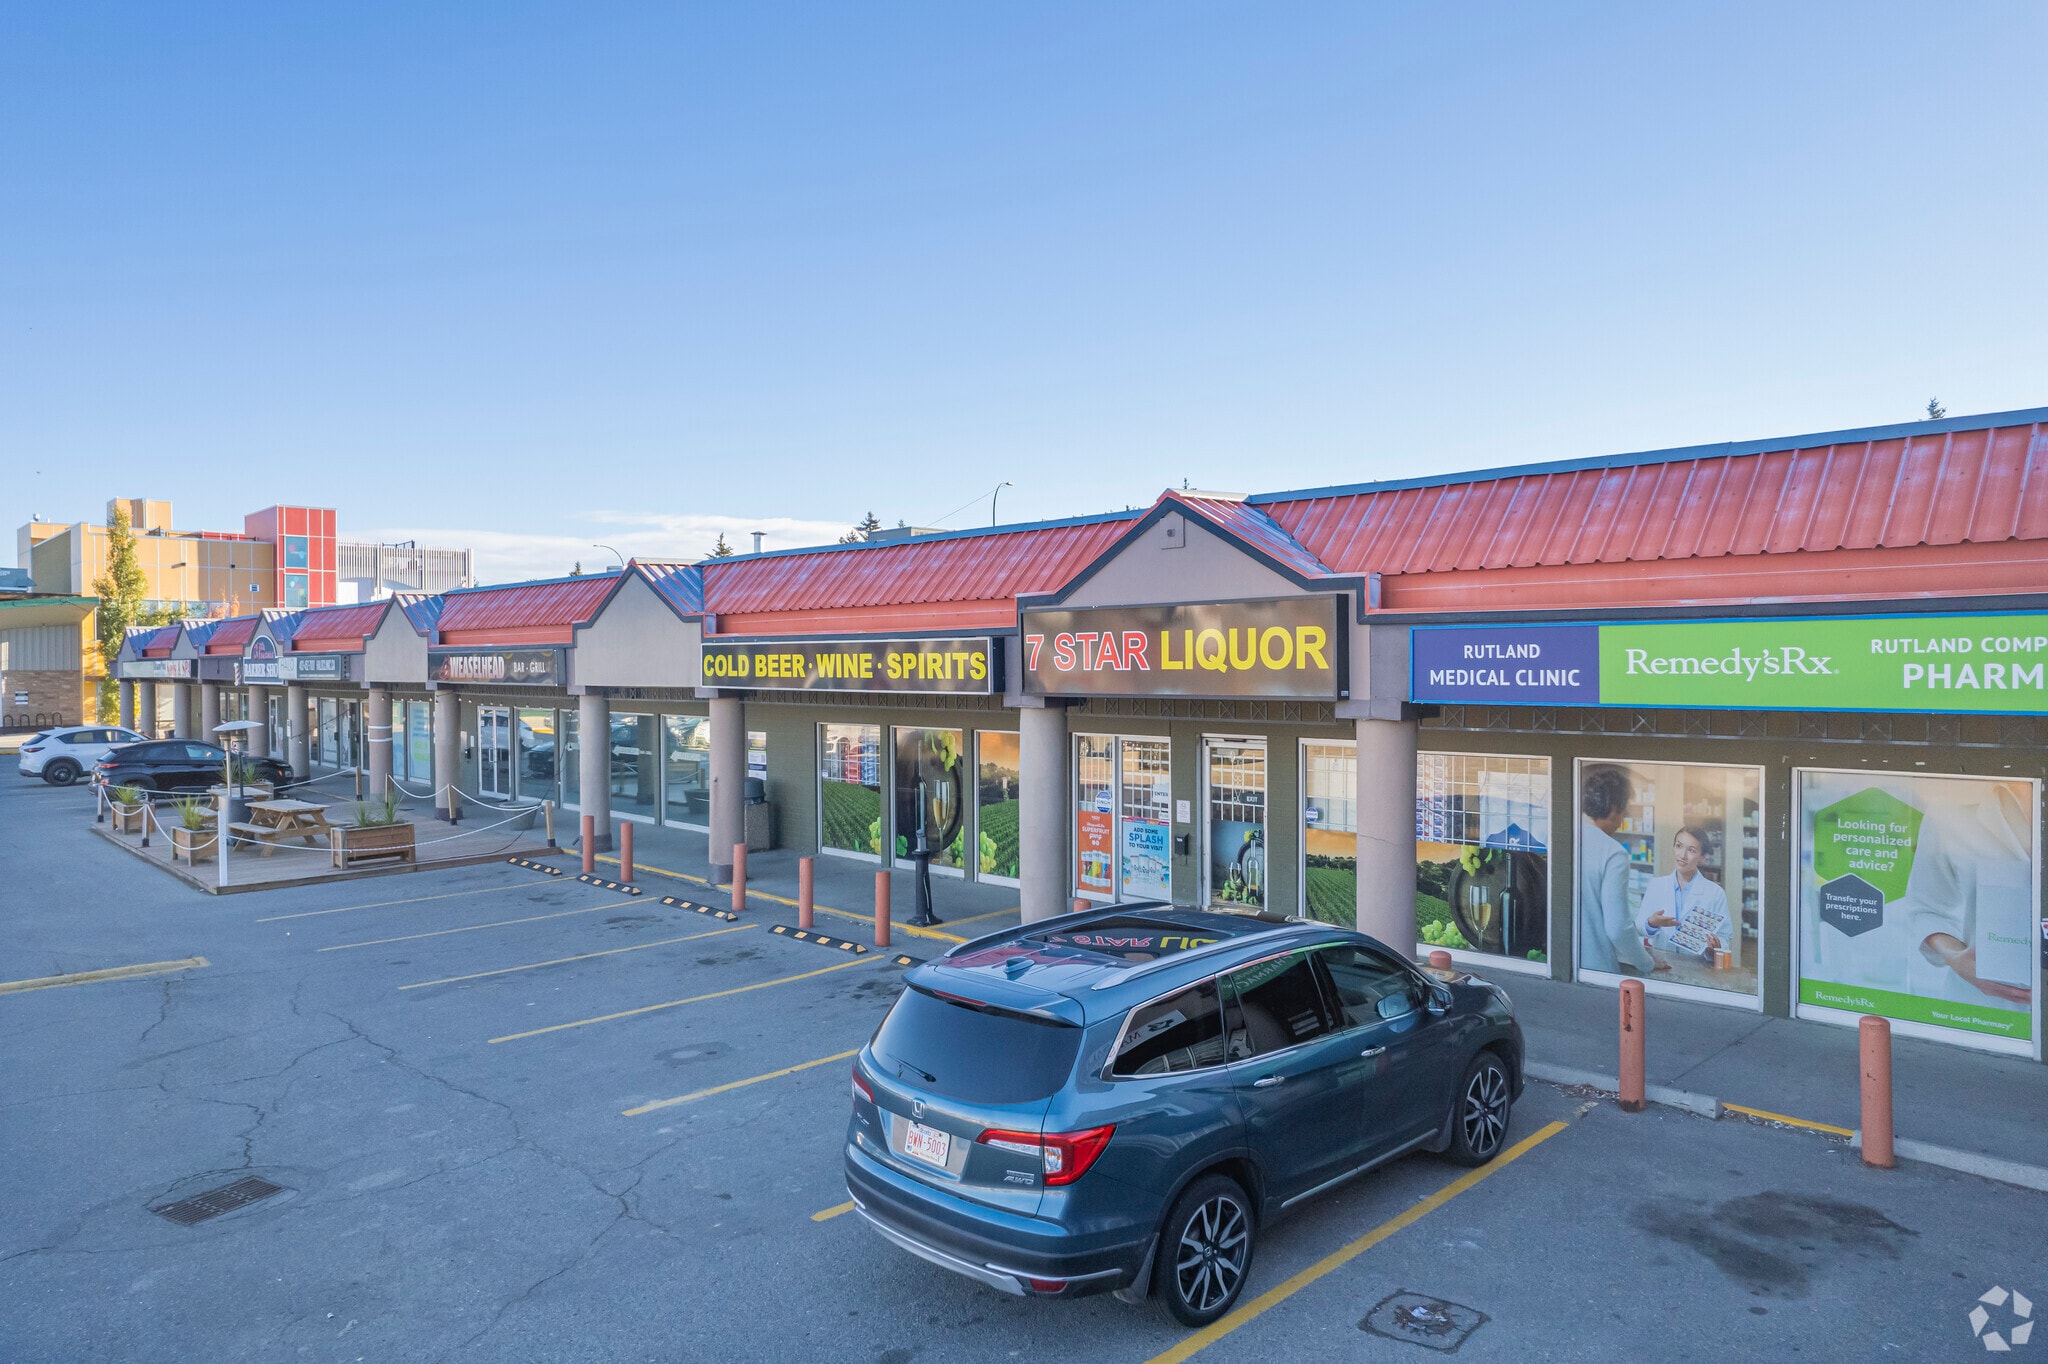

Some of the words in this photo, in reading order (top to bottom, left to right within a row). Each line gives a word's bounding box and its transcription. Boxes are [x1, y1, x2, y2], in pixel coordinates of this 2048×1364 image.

[1025, 634, 1045, 671] 7
[1053, 630, 1151, 671] STAR
[1161, 625, 1329, 674] LIQUOR
[1463, 644, 1541, 659] RUTLAND
[1870, 638, 1973, 654] RUTLAND
[267, 663, 280, 677] SHO
[449, 656, 505, 679] WEASELHEAD
[513, 661, 525, 673] BAR
[530, 661, 546, 673] GRILL
[703, 654, 749, 677] COLD
[755, 653, 806, 678] BEER
[816, 653, 873, 679] WINE
[887, 651, 987, 680] SPIRITS
[1430, 669, 1510, 687] MEDICAL
[1515, 669, 1581, 687] CLINIC
[1903, 663, 2048, 689] PHARM
[1838, 818, 1886, 834] Looking
[1889, 822, 1908, 833] for
[1128, 833, 1164, 845] SPLASH
[1833, 832, 1912, 847] personalized
[1151, 844, 1164, 852] VISIT
[1846, 847, 1872, 857] care
[1875, 849, 1899, 859] and
[1849, 860, 1895, 872] advice?
[1825, 893, 1858, 903] Transfer
[1825, 903, 1878, 915] prescriptions
[1841, 912, 1862, 921] here.
[1931, 1010, 1949, 1020] Your
[1950, 1013, 1971, 1024] Local
[1972, 1017, 2011, 1031] Pharmacy
